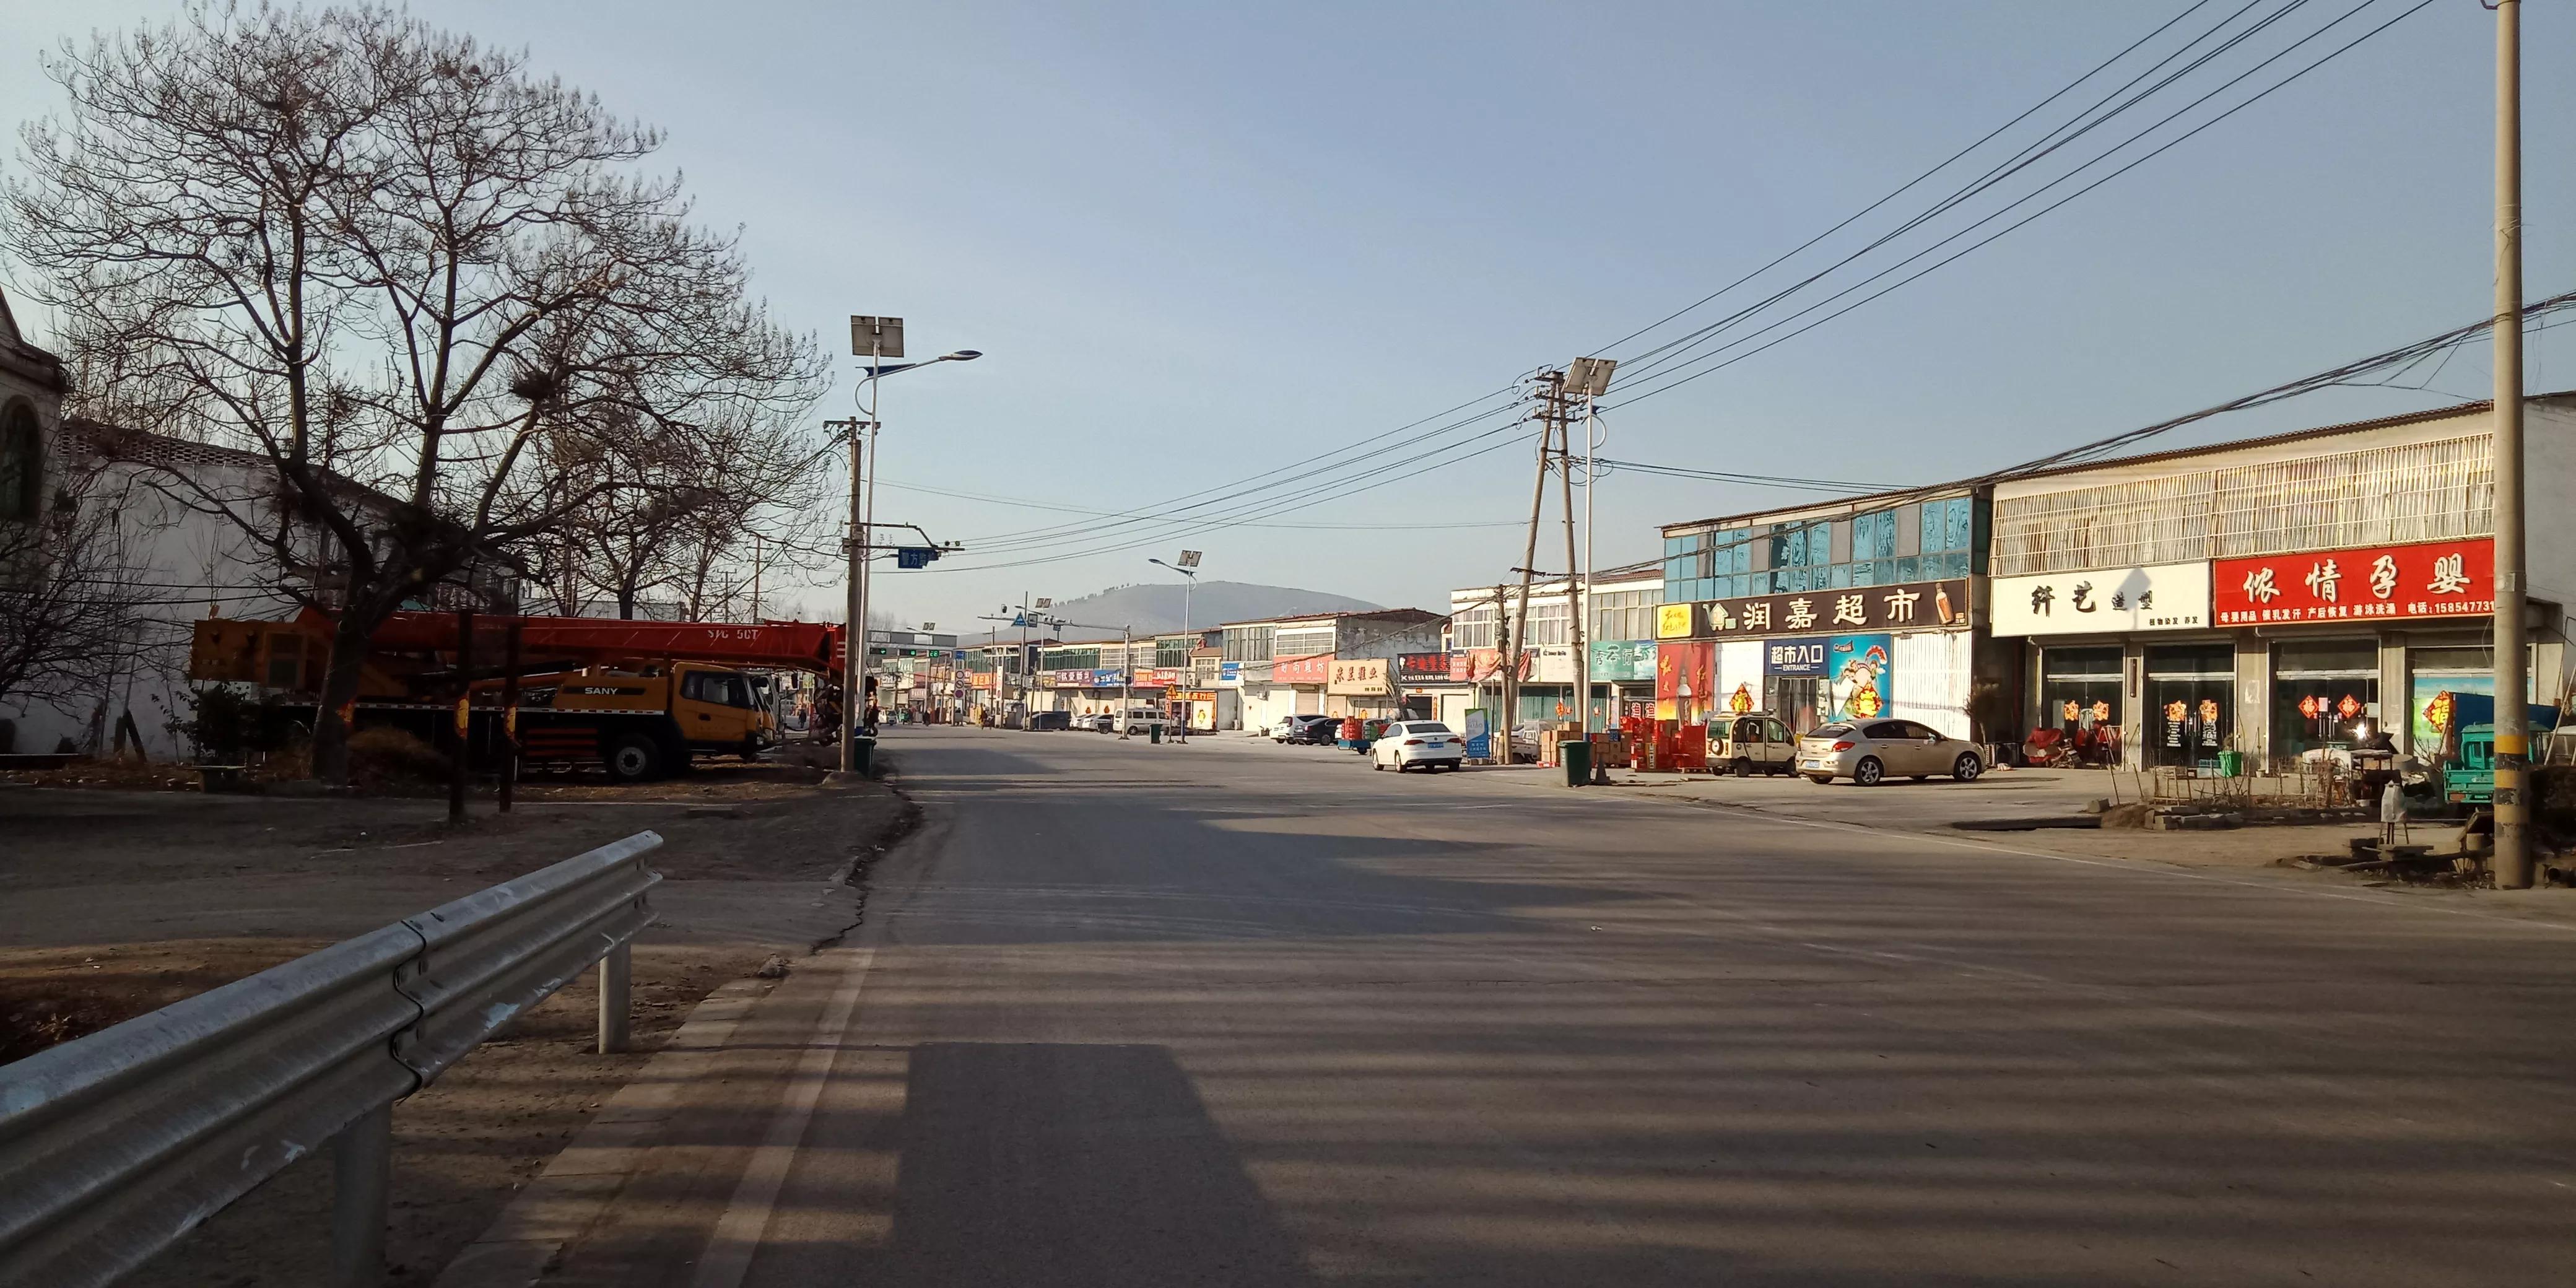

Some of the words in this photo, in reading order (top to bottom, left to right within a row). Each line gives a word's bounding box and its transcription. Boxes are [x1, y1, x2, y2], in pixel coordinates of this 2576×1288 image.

[2243, 553, 2471, 604] 侬情孕婴
[1743, 590, 1920, 630] 润嘉超市
[2220, 611, 2256, 623] 母婴用品
[2307, 606, 2348, 619] 产后恢复
[2353, 603, 2396, 617] 游泳洗澡
[1771, 645, 1823, 664] 超市入口
[585, 687, 618, 695] SANY
